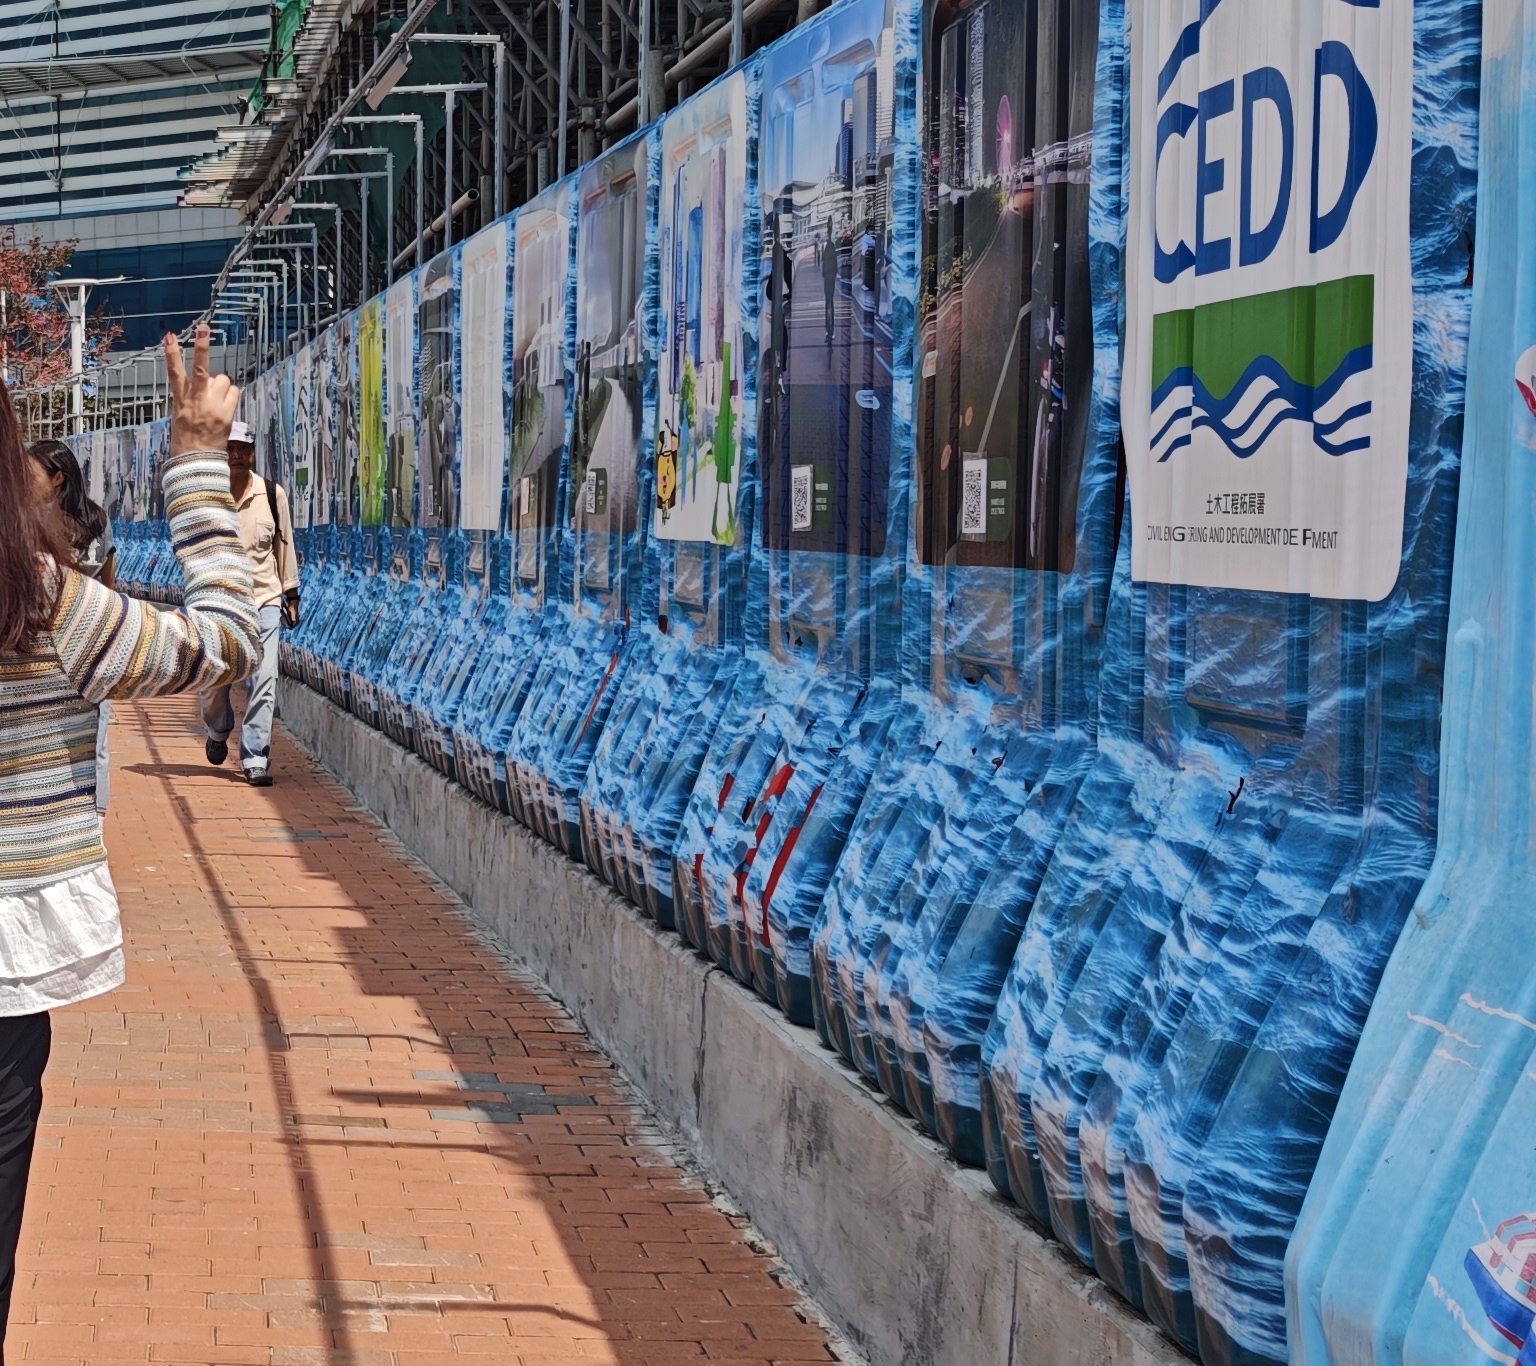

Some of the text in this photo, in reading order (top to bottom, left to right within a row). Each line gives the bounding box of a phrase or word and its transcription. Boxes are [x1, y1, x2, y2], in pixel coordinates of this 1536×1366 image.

[1154, 41, 1378, 284] CEDD
[1205, 492, 1266, 515] 土木工程拓展署
[1209, 526, 1225, 543] AND
[1226, 526, 1282, 545] DEVELOPMENT
